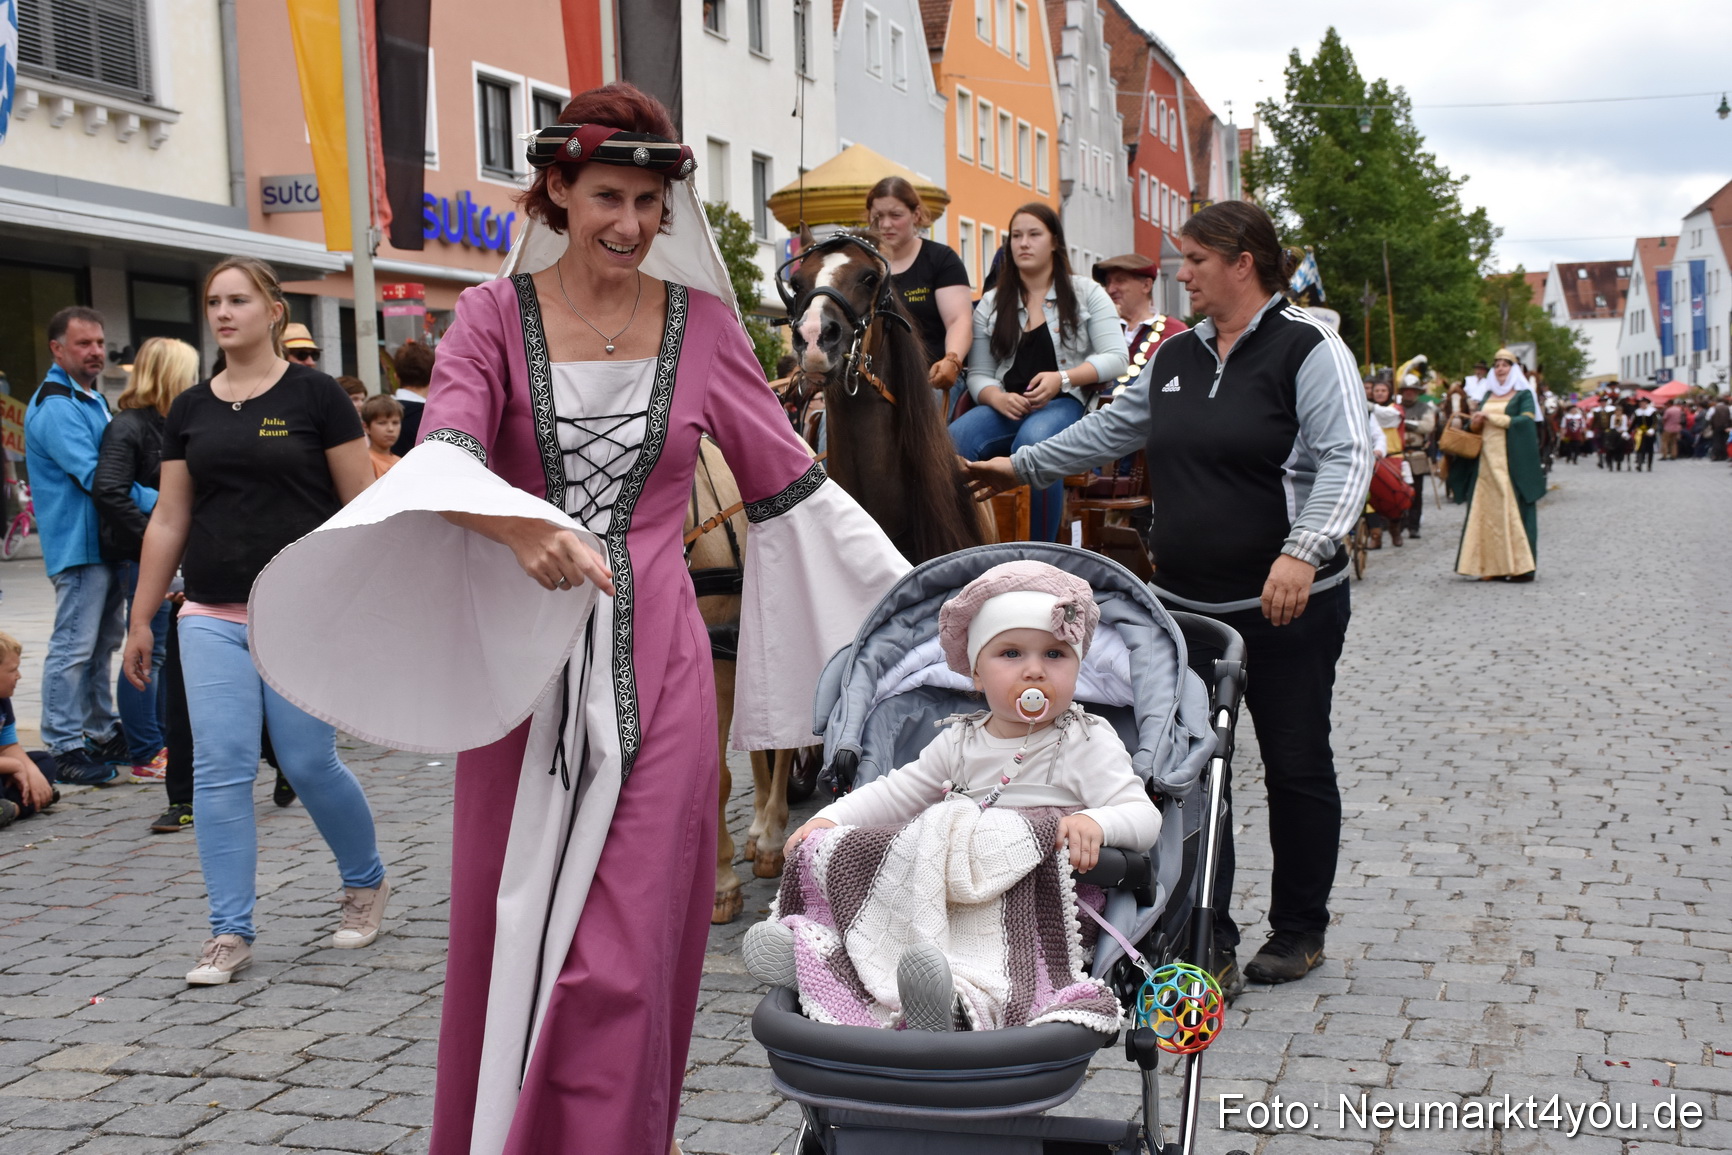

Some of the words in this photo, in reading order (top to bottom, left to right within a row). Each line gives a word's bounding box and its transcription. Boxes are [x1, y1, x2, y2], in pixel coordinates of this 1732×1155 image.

[263, 180, 320, 205] suto
[423, 190, 515, 253] sutor
[261, 417, 286, 427] Julia
[259, 429, 289, 437] Raum
